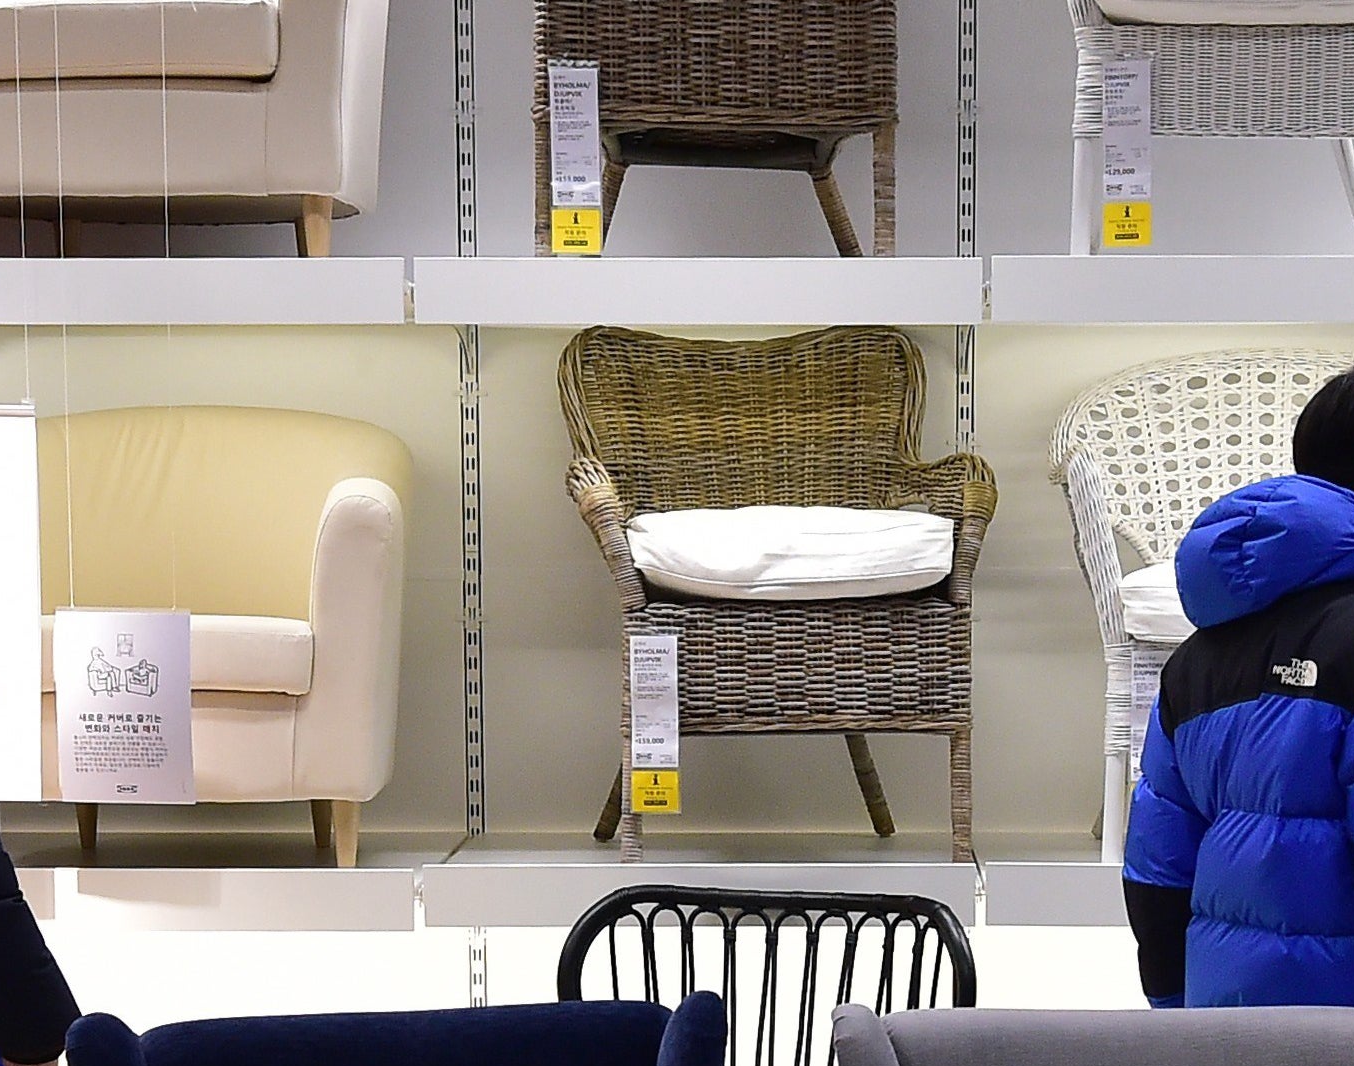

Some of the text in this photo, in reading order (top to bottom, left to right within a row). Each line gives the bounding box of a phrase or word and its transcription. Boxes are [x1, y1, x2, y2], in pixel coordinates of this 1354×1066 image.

[1291, 658, 1308, 670] THE
[1272, 665, 1307, 679] NORTH
[1280, 674, 1307, 686] FACE
[79, 713, 162, 724] 새로운 커버로 즐기는
[85, 724, 110, 733] 변화와
[114, 724, 139, 734] 스타일
